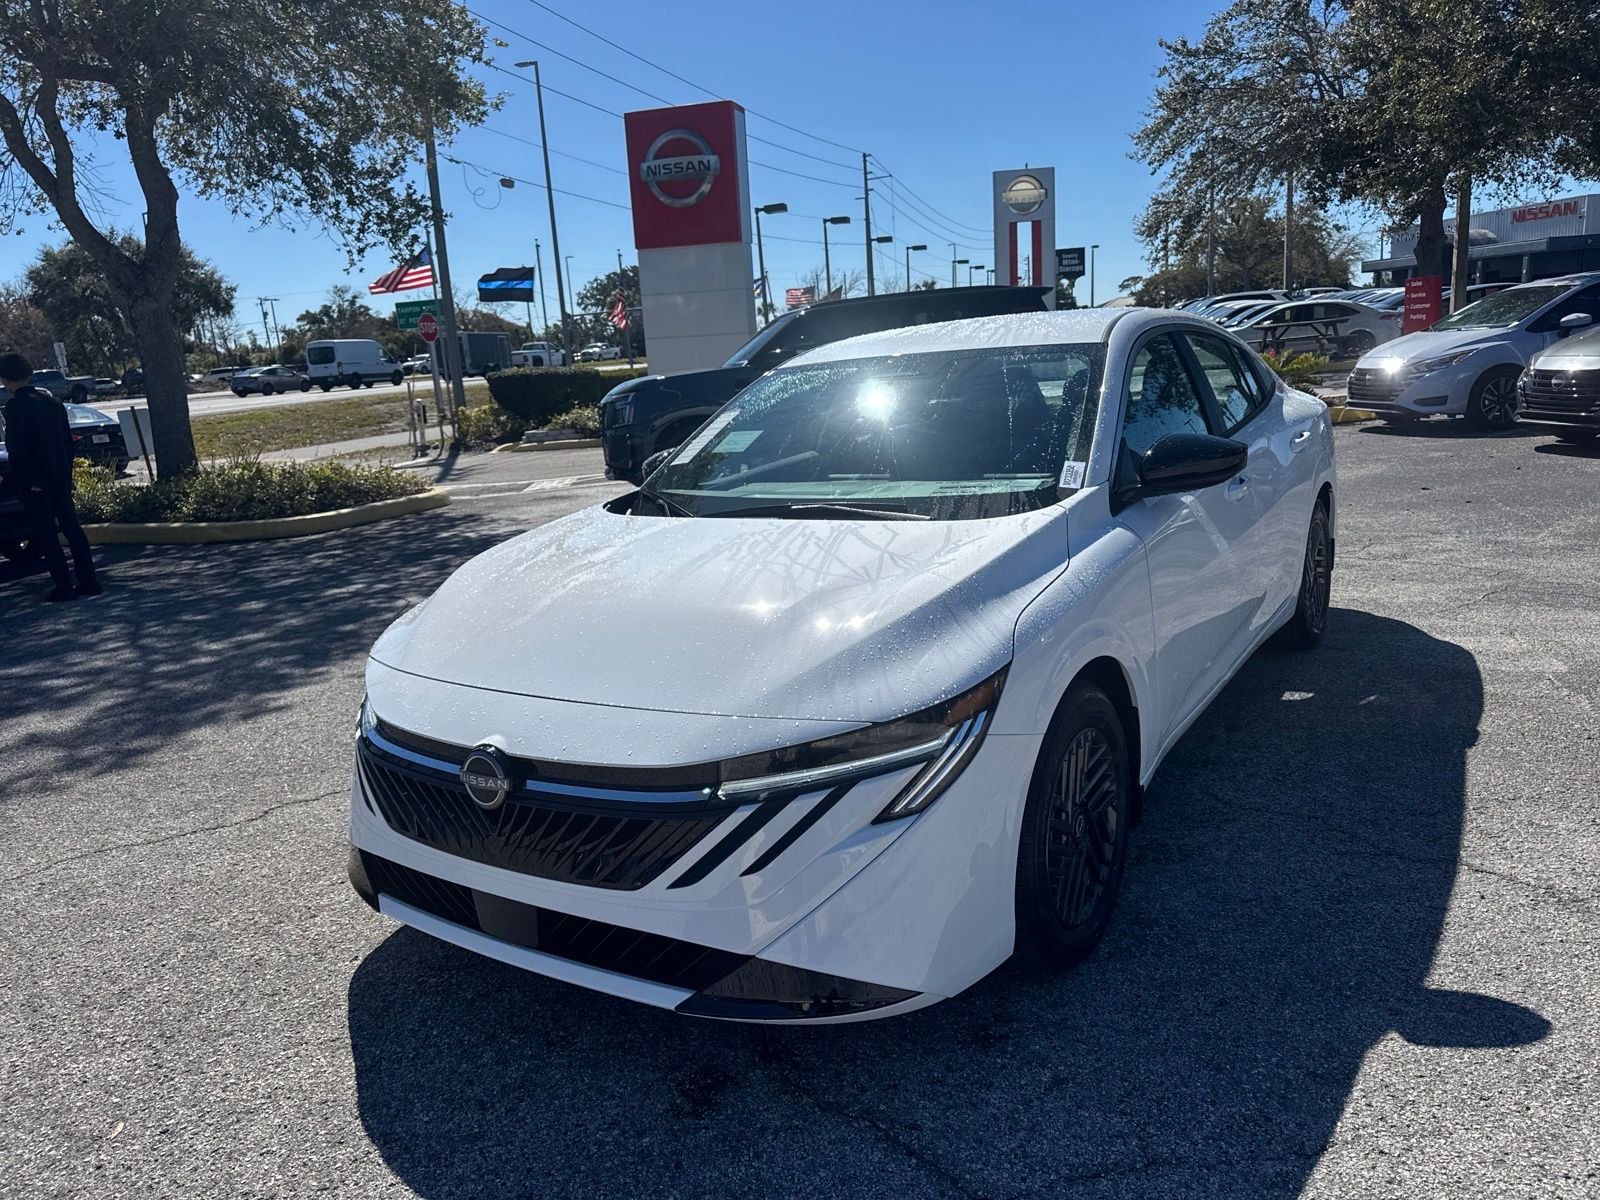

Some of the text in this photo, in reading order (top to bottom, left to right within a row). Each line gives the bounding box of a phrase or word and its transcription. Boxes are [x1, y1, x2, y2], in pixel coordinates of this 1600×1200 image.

[646, 159, 711, 177] NISSAN
[1511, 201, 1577, 224] NISSAN
[420, 321, 437, 334] STOP
[461, 772, 507, 789] NISSAN
